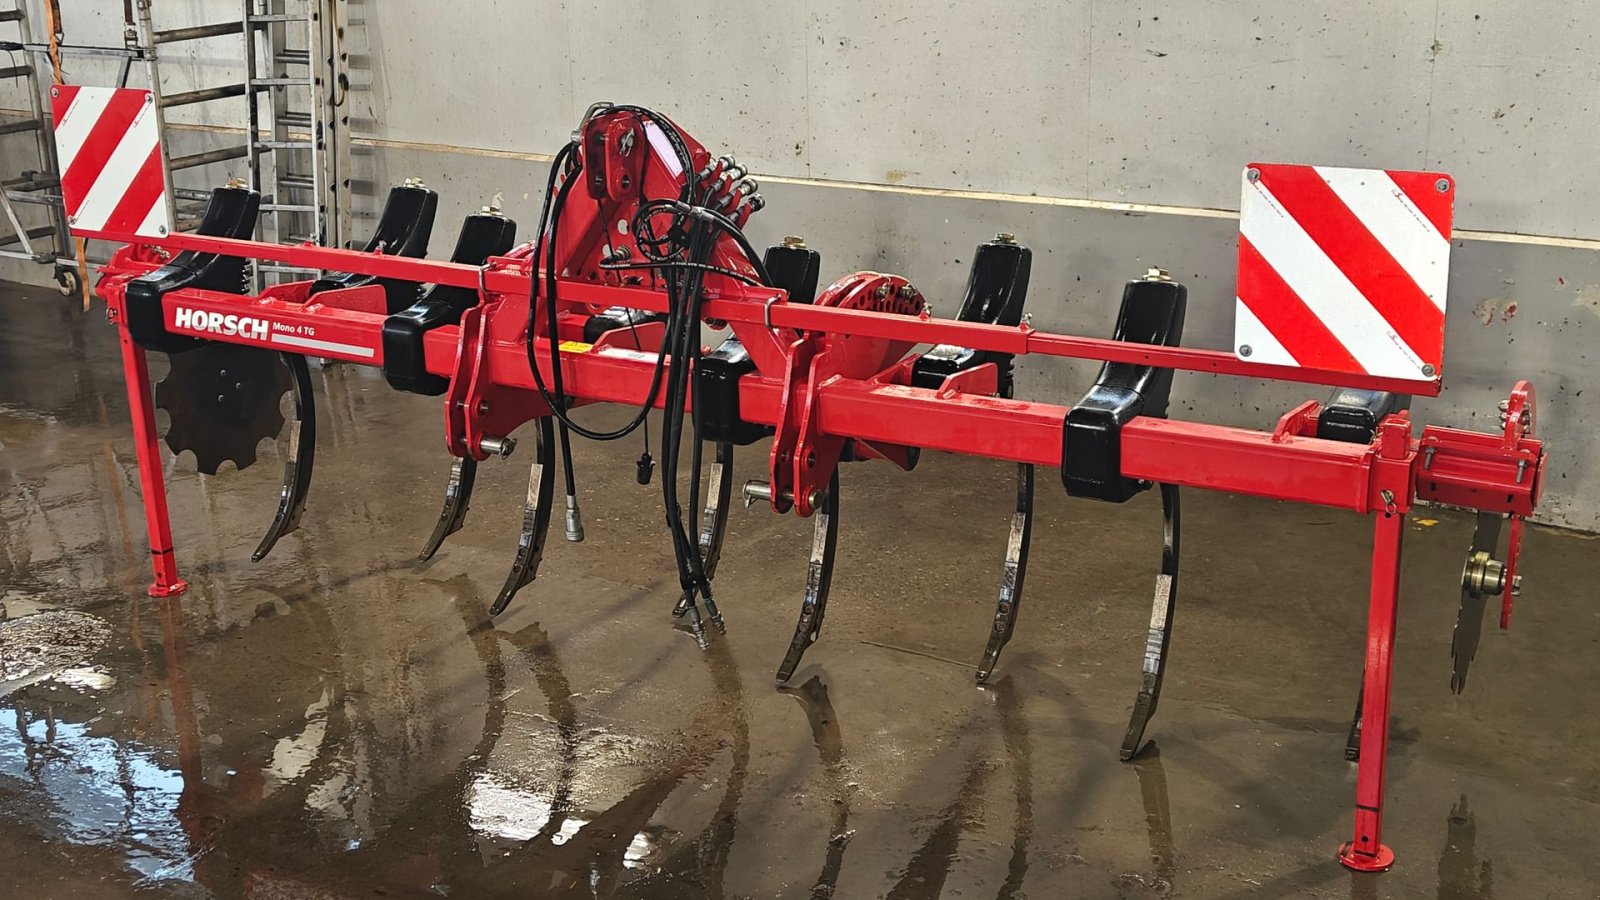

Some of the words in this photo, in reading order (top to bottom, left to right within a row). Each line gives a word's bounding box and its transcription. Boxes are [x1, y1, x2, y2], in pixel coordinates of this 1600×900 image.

[175, 307, 269, 341] HORSCH
[272, 321, 295, 333] Mono
[297, 325, 302, 334] 4
[304, 326, 315, 336] TG
